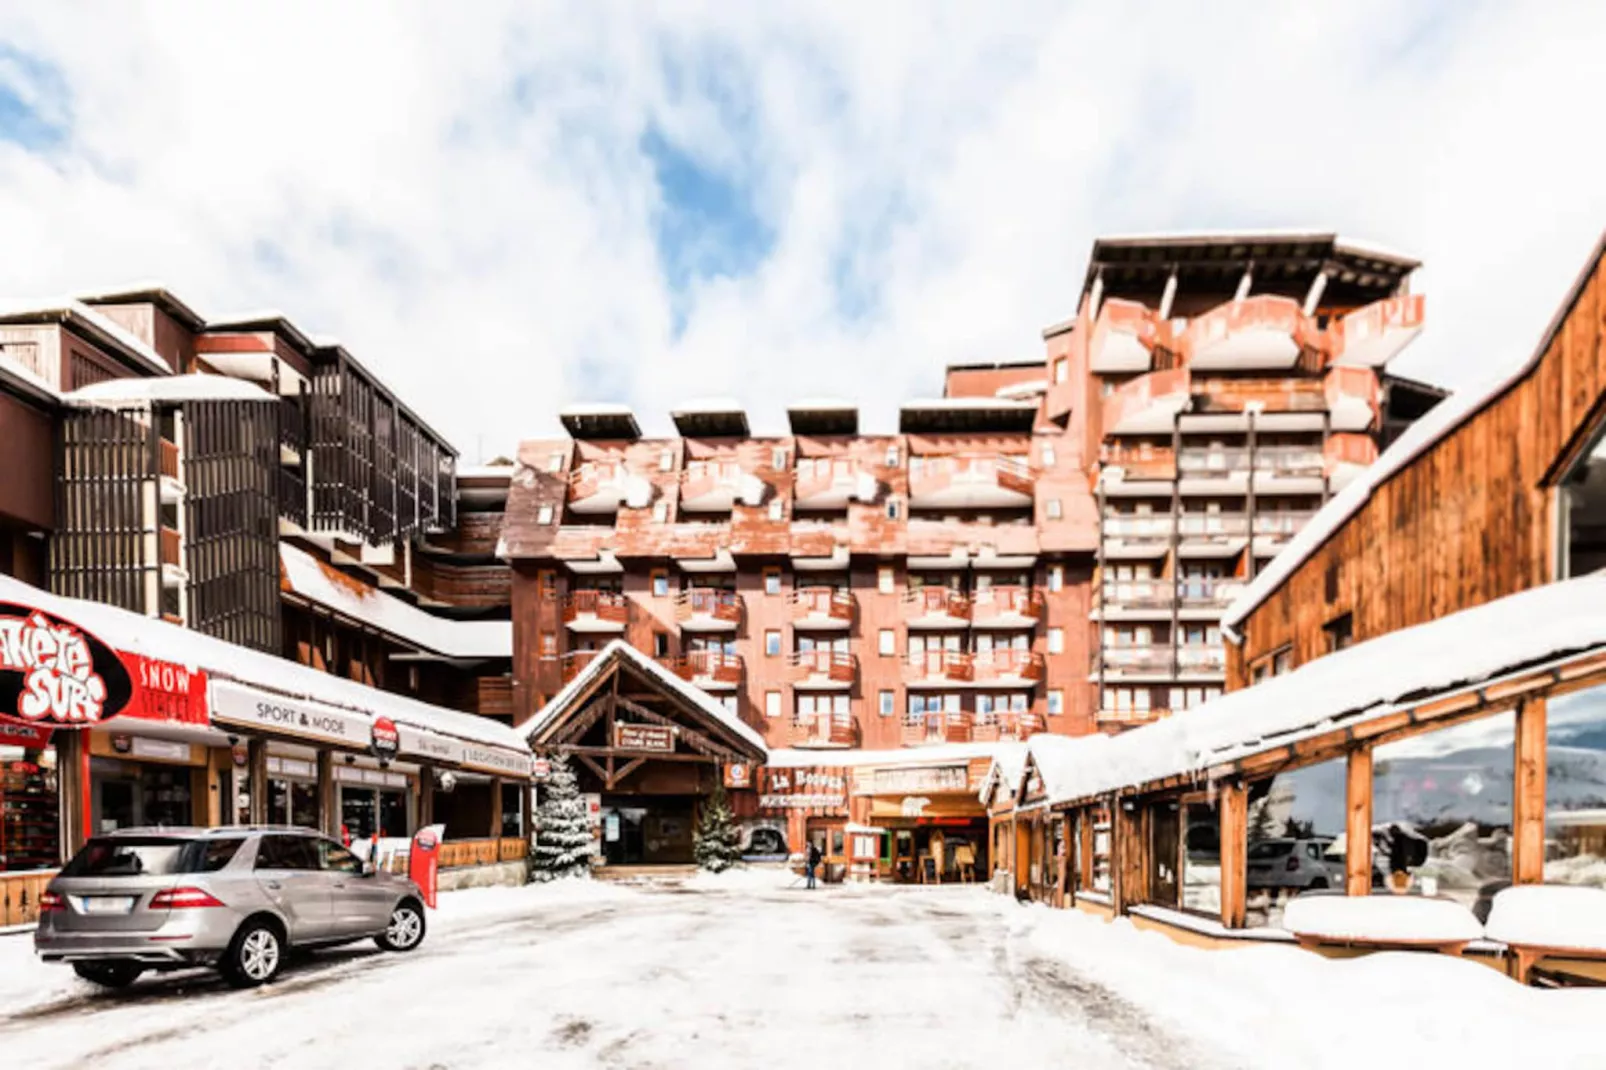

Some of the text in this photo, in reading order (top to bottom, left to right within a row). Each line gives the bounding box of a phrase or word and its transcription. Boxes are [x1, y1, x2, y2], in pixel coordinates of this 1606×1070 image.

[21, 667, 104, 721] SURF
[139, 661, 190, 695] SNOW
[256, 702, 346, 735] SPORT & MODE
